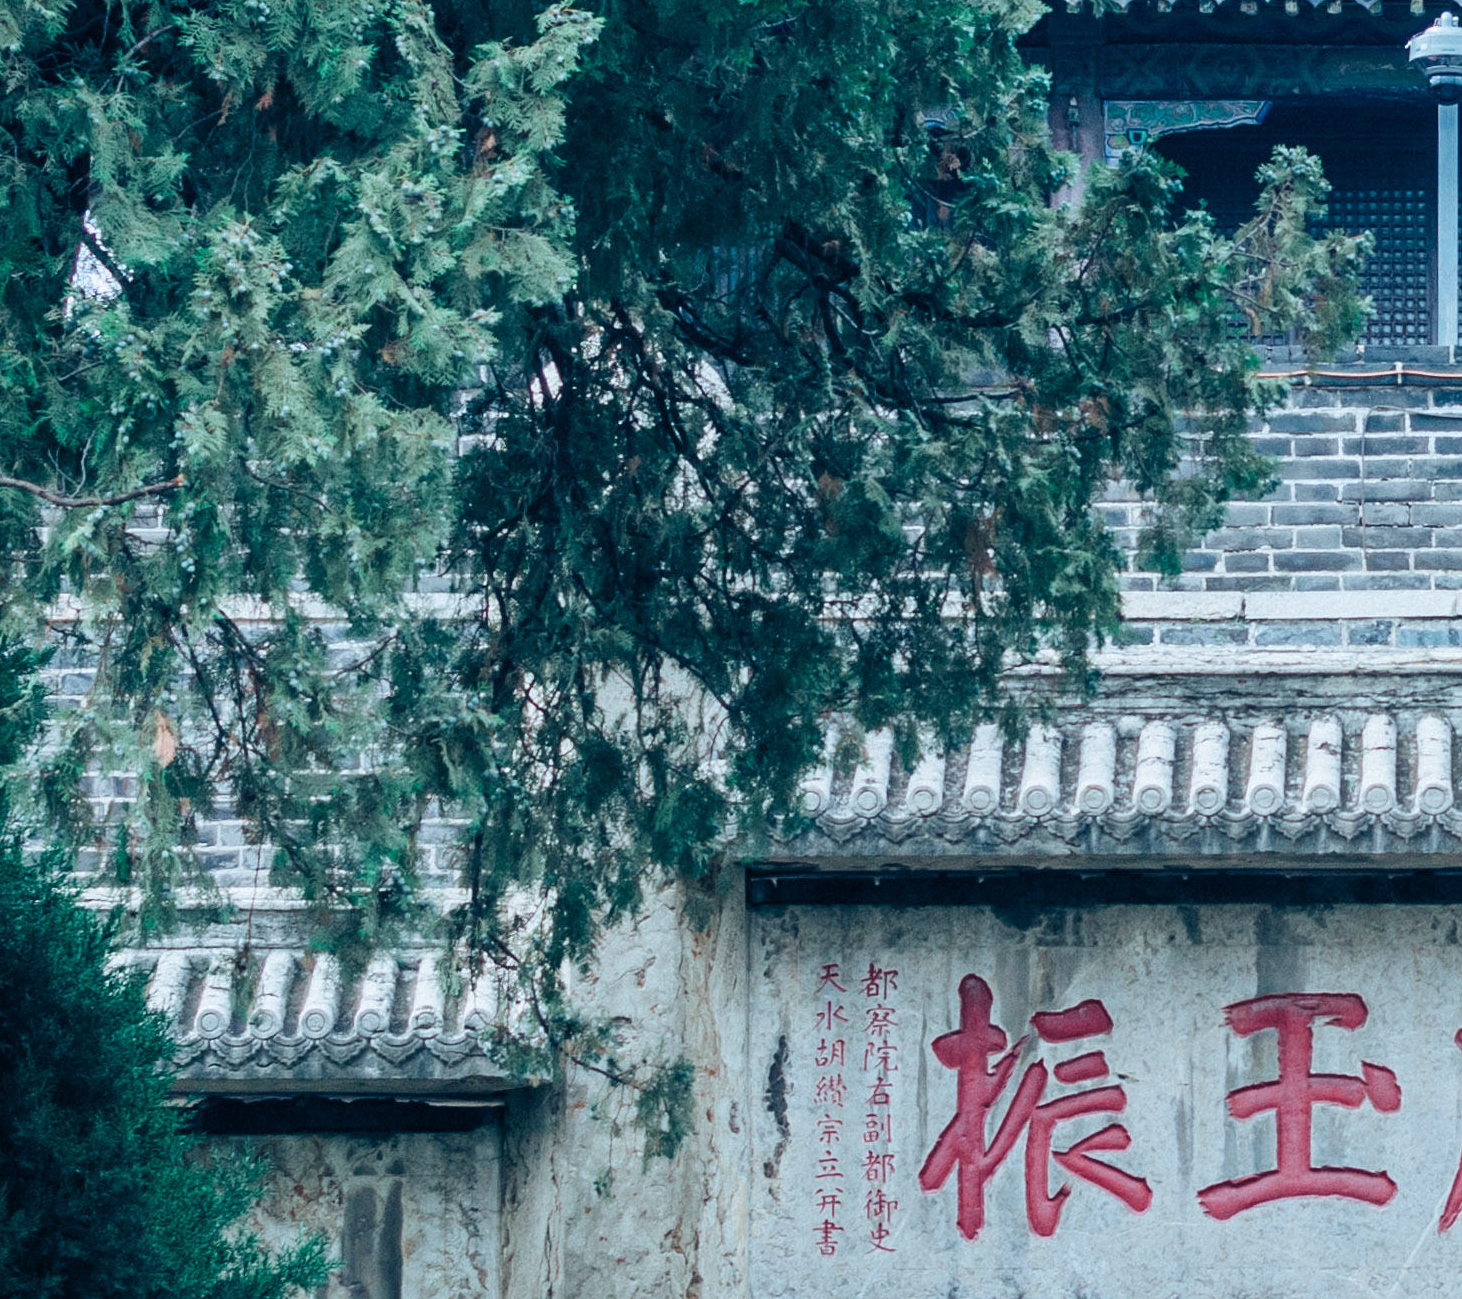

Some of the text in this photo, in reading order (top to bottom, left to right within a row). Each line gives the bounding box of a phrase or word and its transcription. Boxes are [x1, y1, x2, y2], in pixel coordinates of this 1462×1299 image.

[858, 962, 899, 1255] 都察院右副都御史
